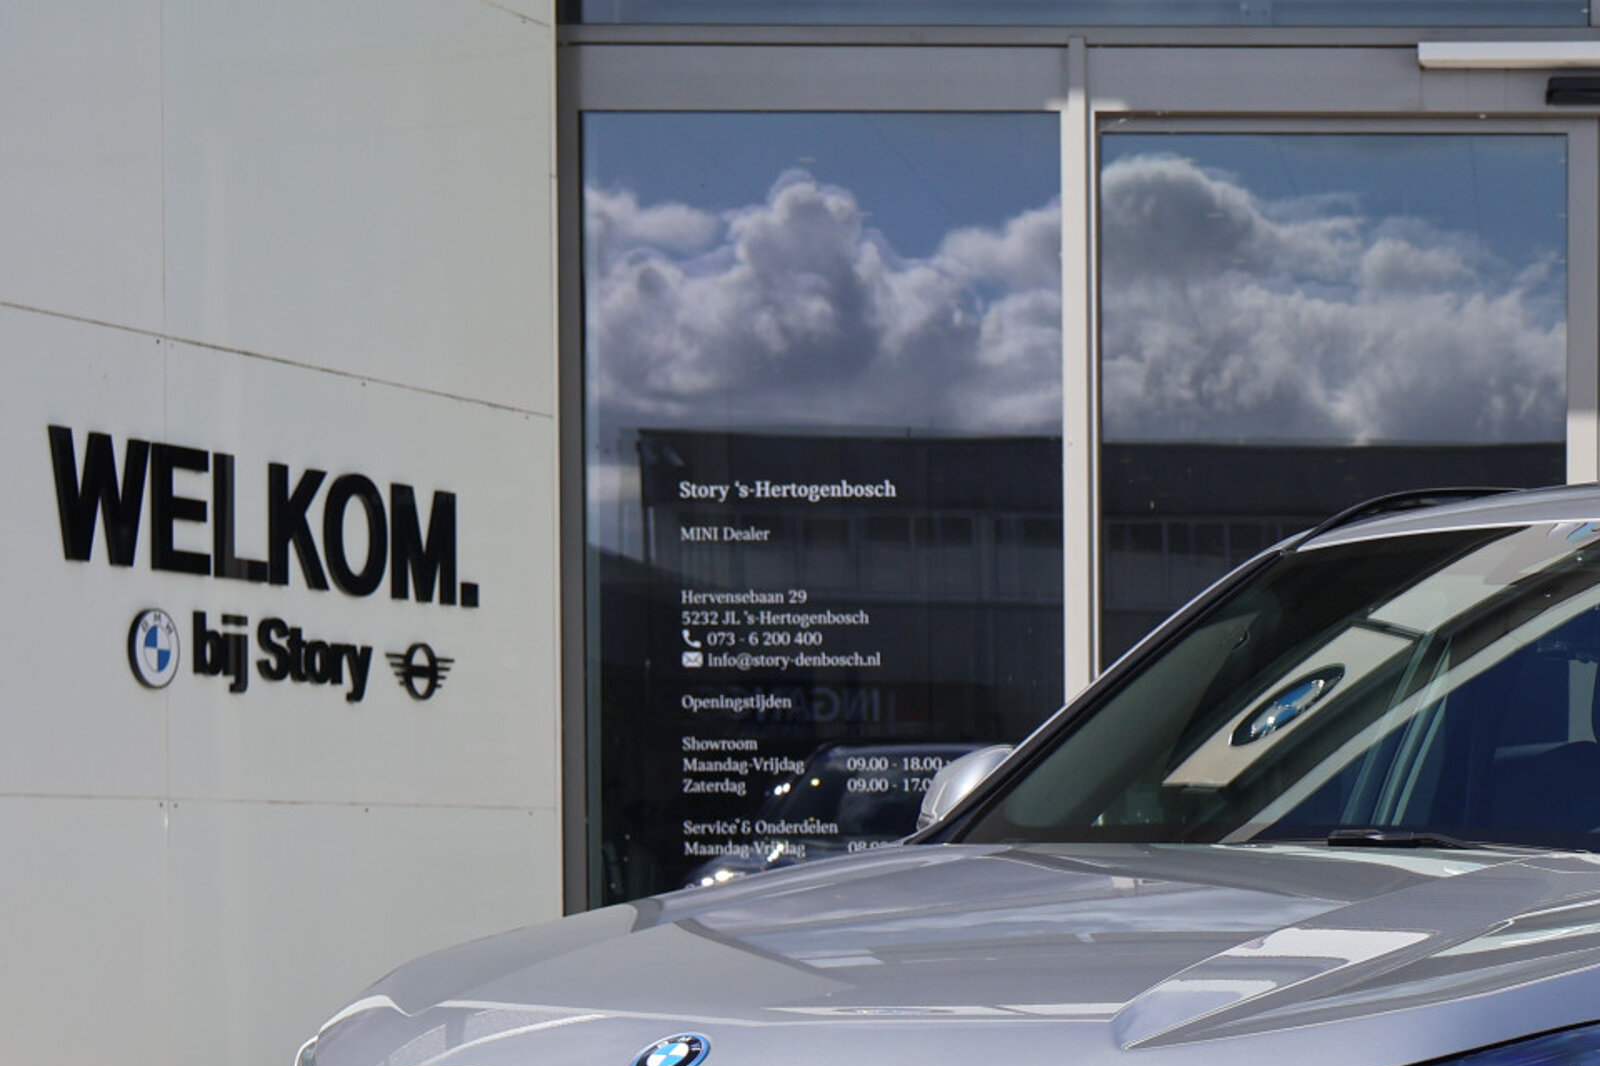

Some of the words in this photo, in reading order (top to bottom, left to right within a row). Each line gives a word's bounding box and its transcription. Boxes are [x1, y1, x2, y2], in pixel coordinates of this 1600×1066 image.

[679, 480, 729, 502] Story
[47, 424, 479, 607] WELKOM.
[680, 525, 719, 541] MINI
[723, 525, 770, 541] Dealer
[681, 589, 785, 604] Hervensebaan
[788, 589, 808, 604] 29
[681, 610, 719, 626] 5232
[721, 610, 741, 626] JL
[706, 631, 736, 646] 073
[748, 631, 759, 646] 6
[762, 631, 791, 646] 200
[794, 631, 823, 646] 400
[193, 610, 247, 693] bij
[256, 617, 373, 702] Story
[681, 695, 792, 711] Openingstijden
[682, 736, 758, 752] Showroom
[847, 756, 889, 771] 09.00
[683, 777, 747, 795] Zaterdag
[847, 777, 889, 792] 09.00
[903, 777, 932, 792] 17.0
[683, 820, 737, 836] Service
[755, 819, 839, 836] Onderdelen
